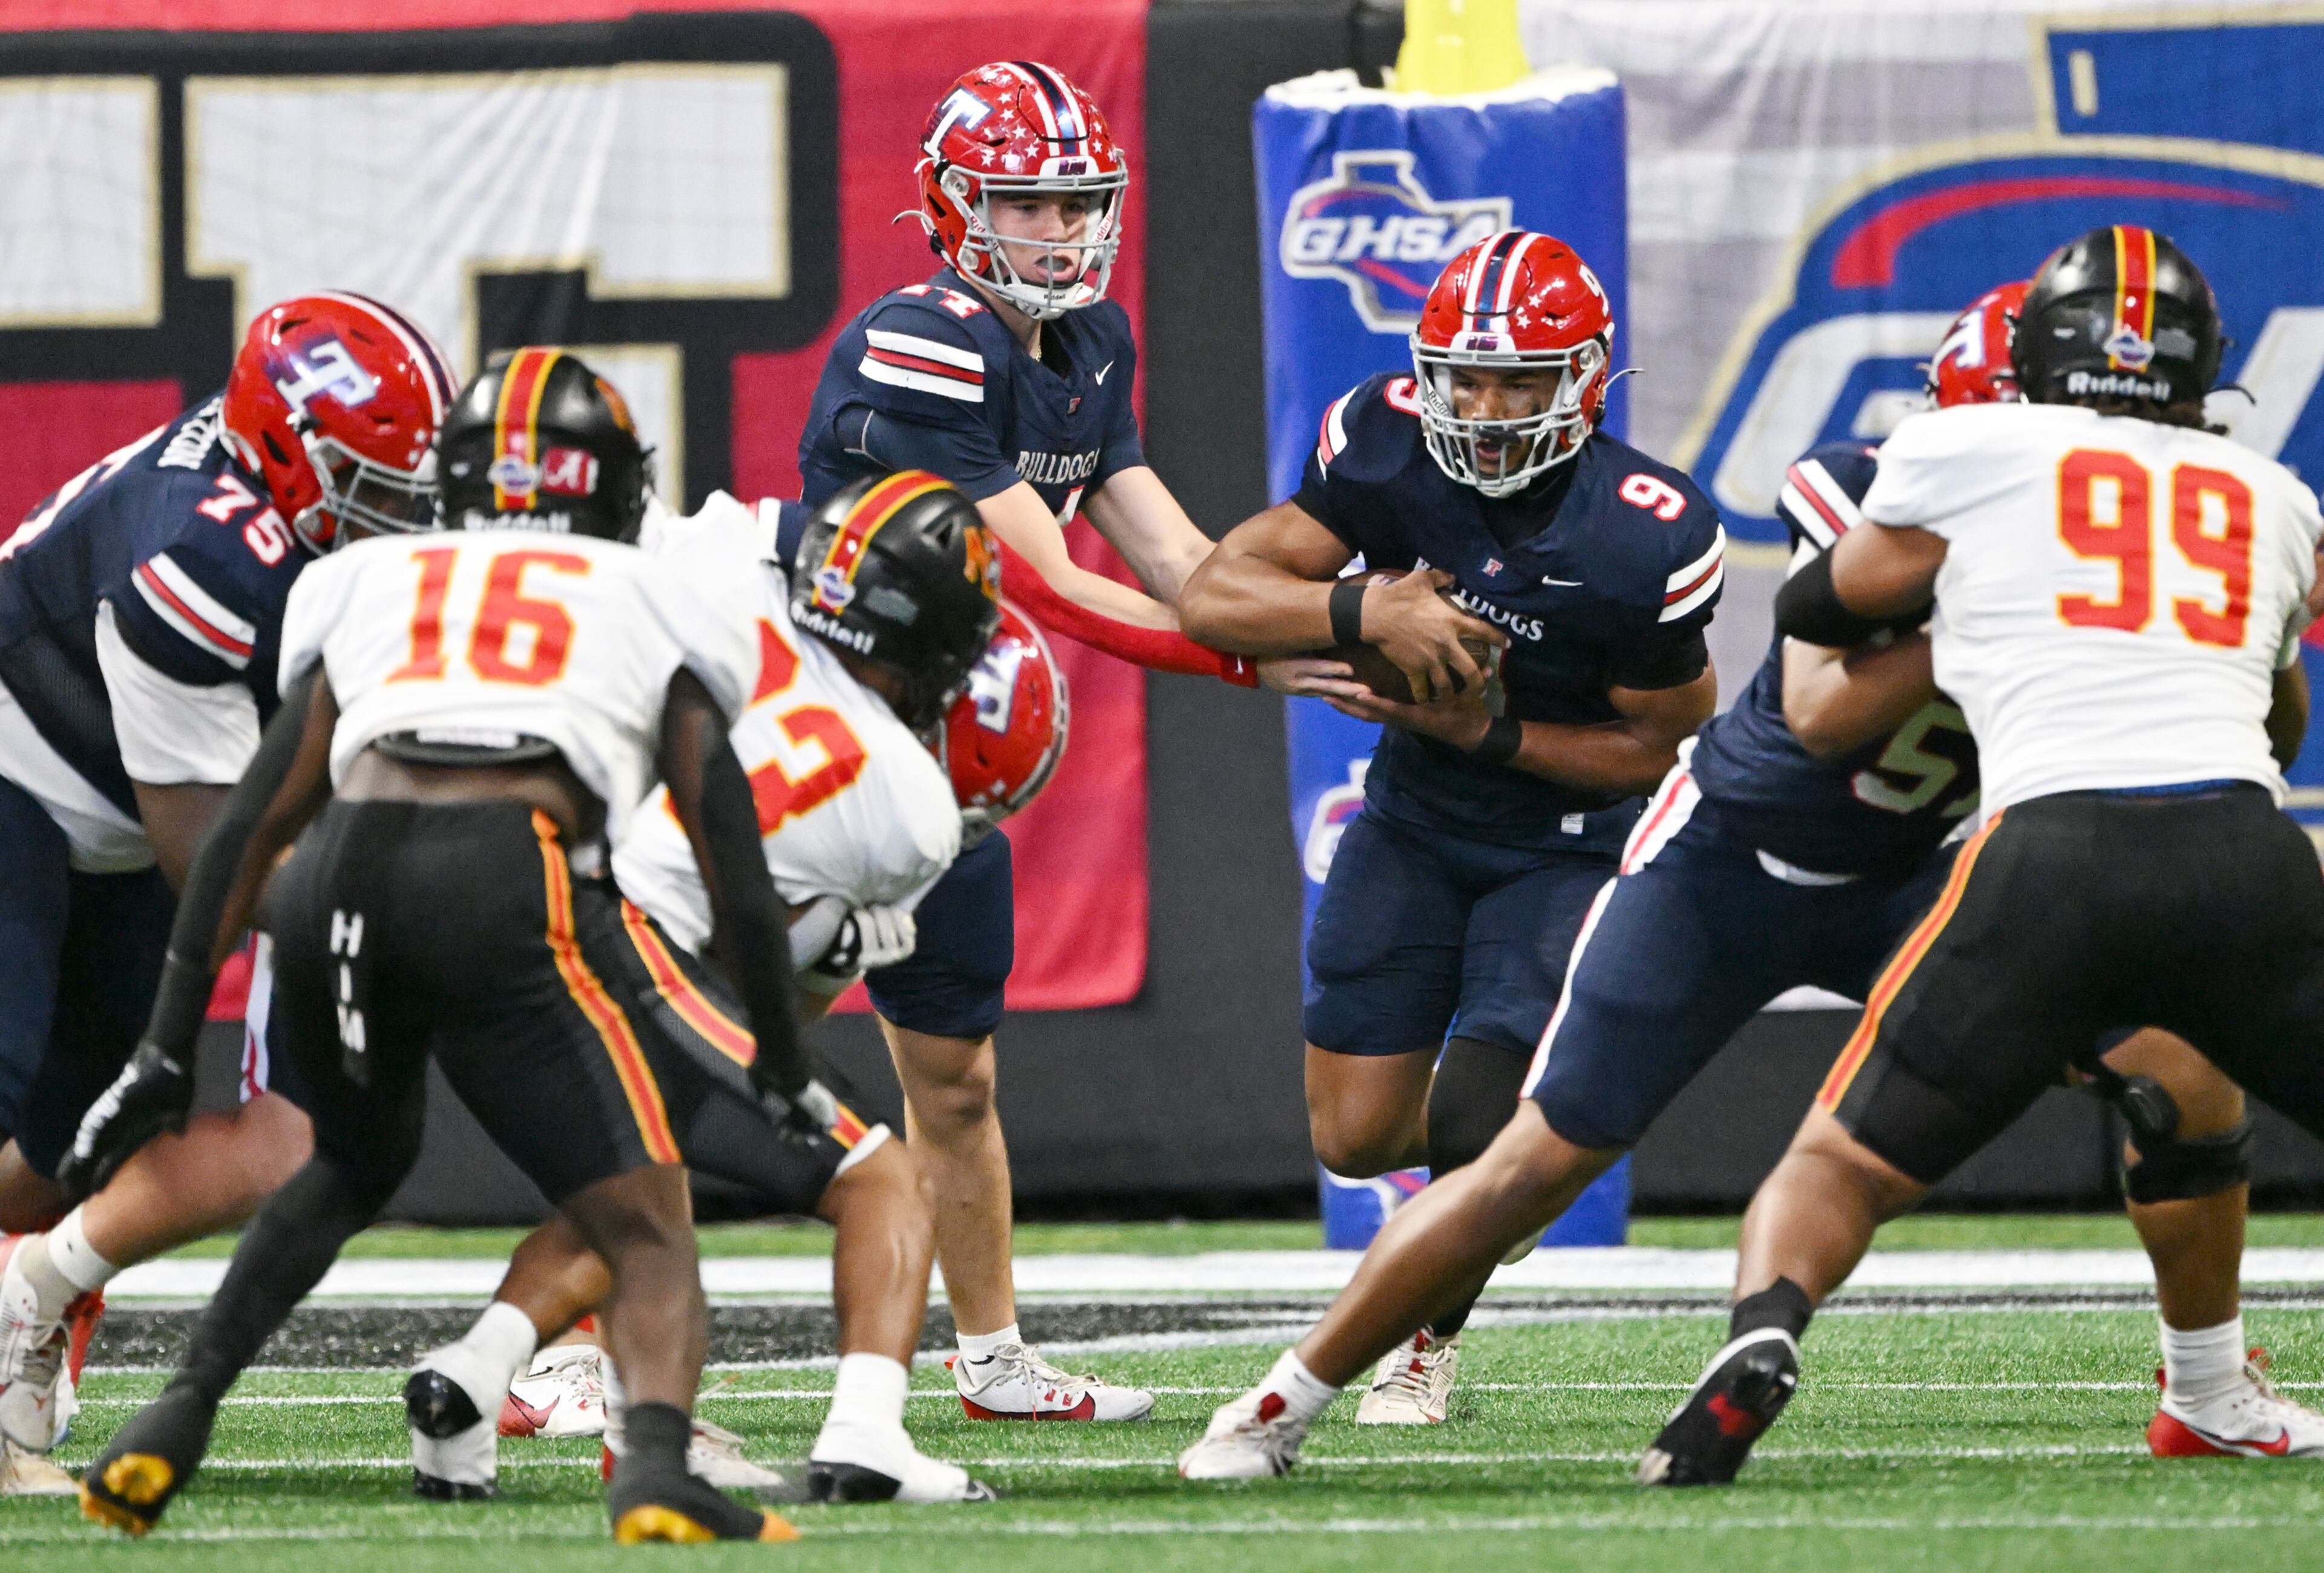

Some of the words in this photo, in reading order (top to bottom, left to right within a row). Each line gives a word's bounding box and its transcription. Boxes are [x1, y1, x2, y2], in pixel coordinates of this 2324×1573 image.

[2067, 371, 2171, 401] Riddell
[197, 474, 295, 568] 75
[1618, 473, 1687, 522] 9
[2056, 447, 2254, 648] 99
[384, 547, 592, 689] 16
[1851, 699, 1980, 818] 5
